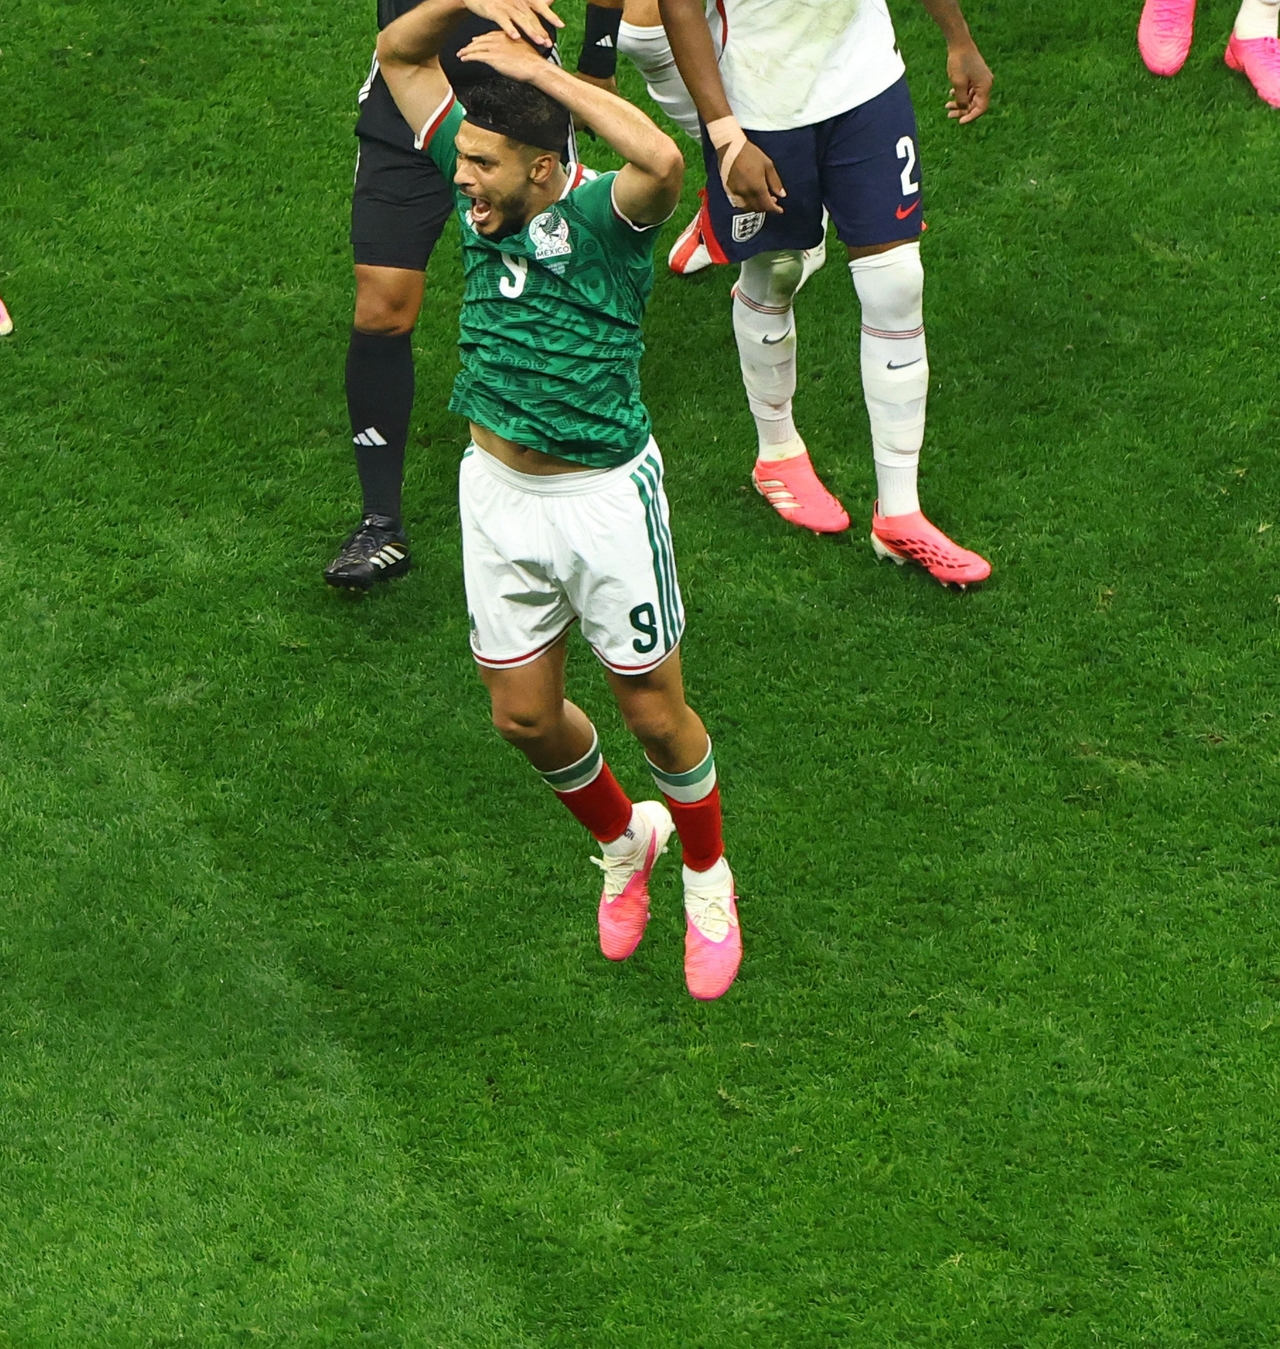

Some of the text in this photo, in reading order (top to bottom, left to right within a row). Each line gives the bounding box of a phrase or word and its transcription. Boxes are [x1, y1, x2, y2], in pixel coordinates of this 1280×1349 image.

[895, 136, 919, 196] 2
[499, 251, 528, 299] 9
[537, 246, 570, 257] MEXICO
[629, 602, 658, 654] 9
